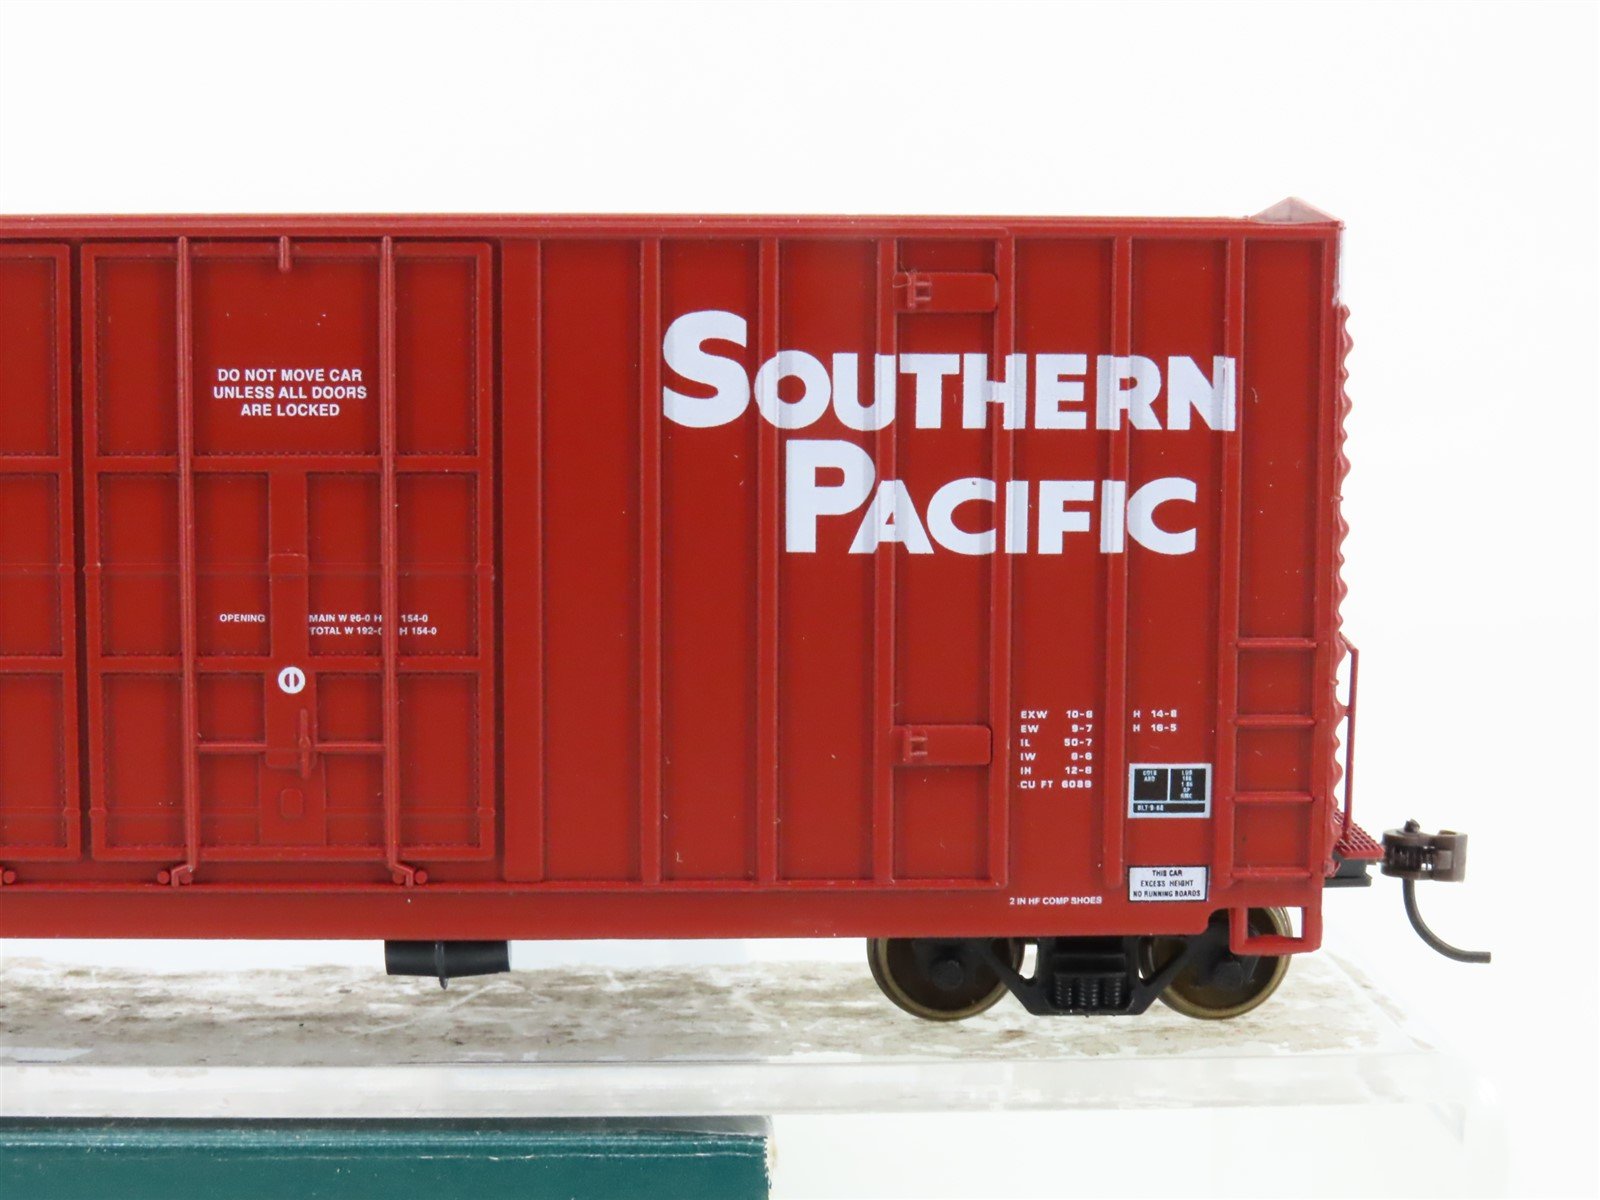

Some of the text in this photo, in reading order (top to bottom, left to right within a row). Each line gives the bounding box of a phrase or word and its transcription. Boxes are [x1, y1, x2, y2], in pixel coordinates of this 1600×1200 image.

[218, 369, 362, 381] DO NOT MOVE CAR
[663, 310, 1236, 432] SOUTHERN
[213, 386, 367, 399] UNLESS ALL DOORS
[241, 404, 340, 416] ARE LOCKED
[785, 439, 1197, 555] PACIFIC
[219, 614, 266, 623] OPENING
[309, 614, 335, 622] MAIN
[338, 614, 347, 622] W
[309, 627, 341, 635] TOTAL
[344, 627, 354, 635] W
[1020, 710, 1048, 719] EXW
[1133, 710, 1141, 719] H
[1020, 724, 1039, 733] EW
[1133, 724, 1141, 733] H
[1020, 738, 1093, 747] IL 50-7
[1020, 752, 1036, 761] IW
[1020, 766, 1032, 775] IH
[1020, 780, 1036, 789] CU
[1041, 780, 1054, 789] FT
[1152, 869, 1183, 877] THIS CAR
[1169, 879, 1194, 887] HEIGHT
[1009, 897, 1015, 905] 2
[1017, 897, 1026, 905] IN
[1042, 897, 1069, 905] COMP
[1070, 896, 1102, 904] SHOES
